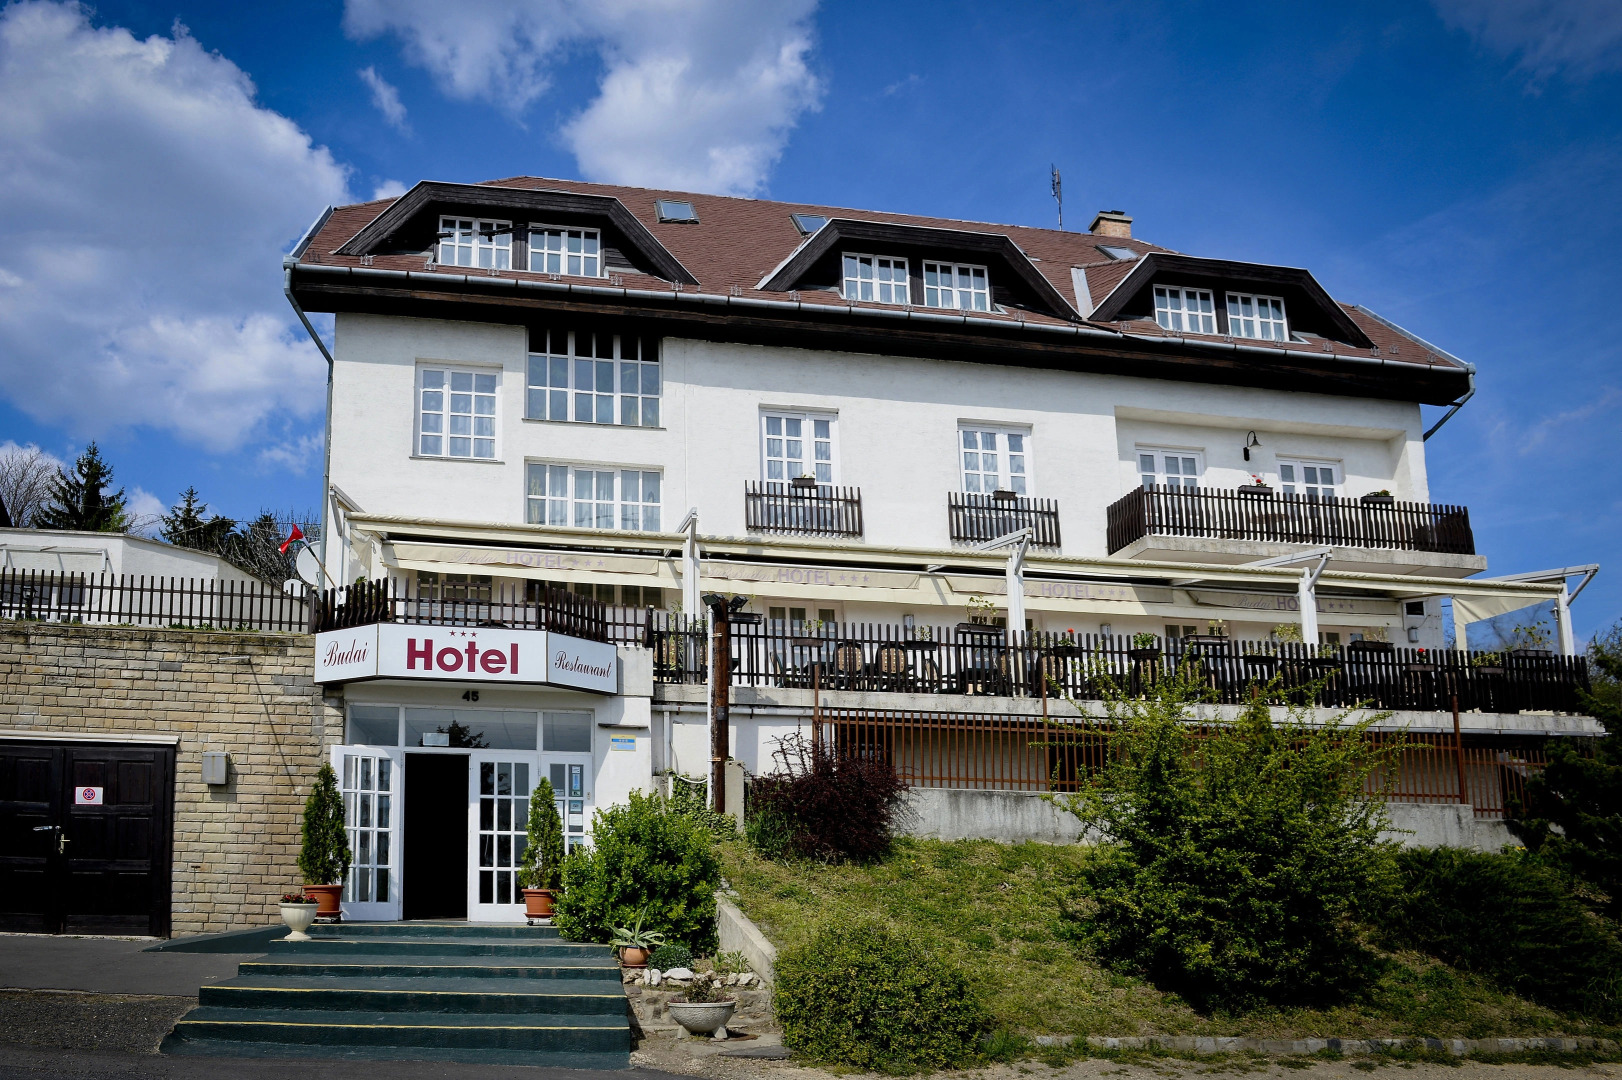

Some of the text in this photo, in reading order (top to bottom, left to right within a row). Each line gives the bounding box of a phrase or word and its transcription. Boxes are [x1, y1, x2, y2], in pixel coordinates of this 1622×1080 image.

[506, 552, 567, 569] HOTEL
[777, 568, 835, 585] HOTEL
[1041, 583, 1095, 598] HOTEL
[1277, 596, 1326, 612] HOL
[323, 638, 612, 679] Budai Hotel Restaurant
[462, 691, 479, 702] 45
